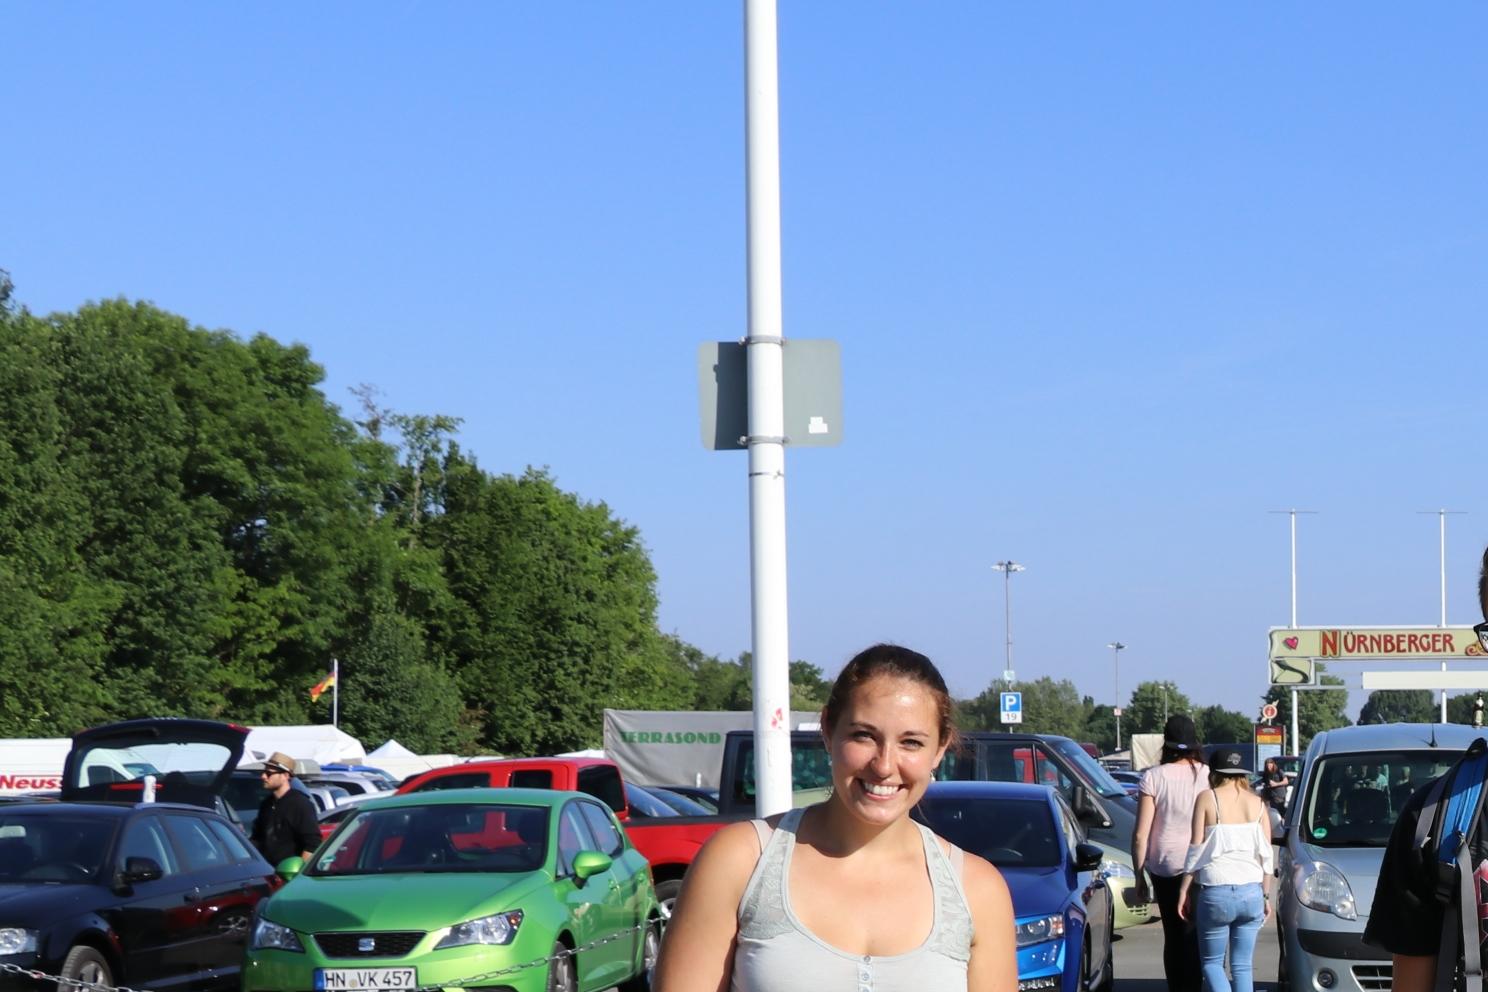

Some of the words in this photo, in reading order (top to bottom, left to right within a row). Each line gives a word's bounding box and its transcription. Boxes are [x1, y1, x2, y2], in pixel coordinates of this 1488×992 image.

[1321, 630, 1455, 657] NÜRNBERGER
[1005, 695, 1017, 711] P
[325, 972, 345, 987] HN
[357, 972, 378, 987] VK
[383, 971, 412, 986] 457
